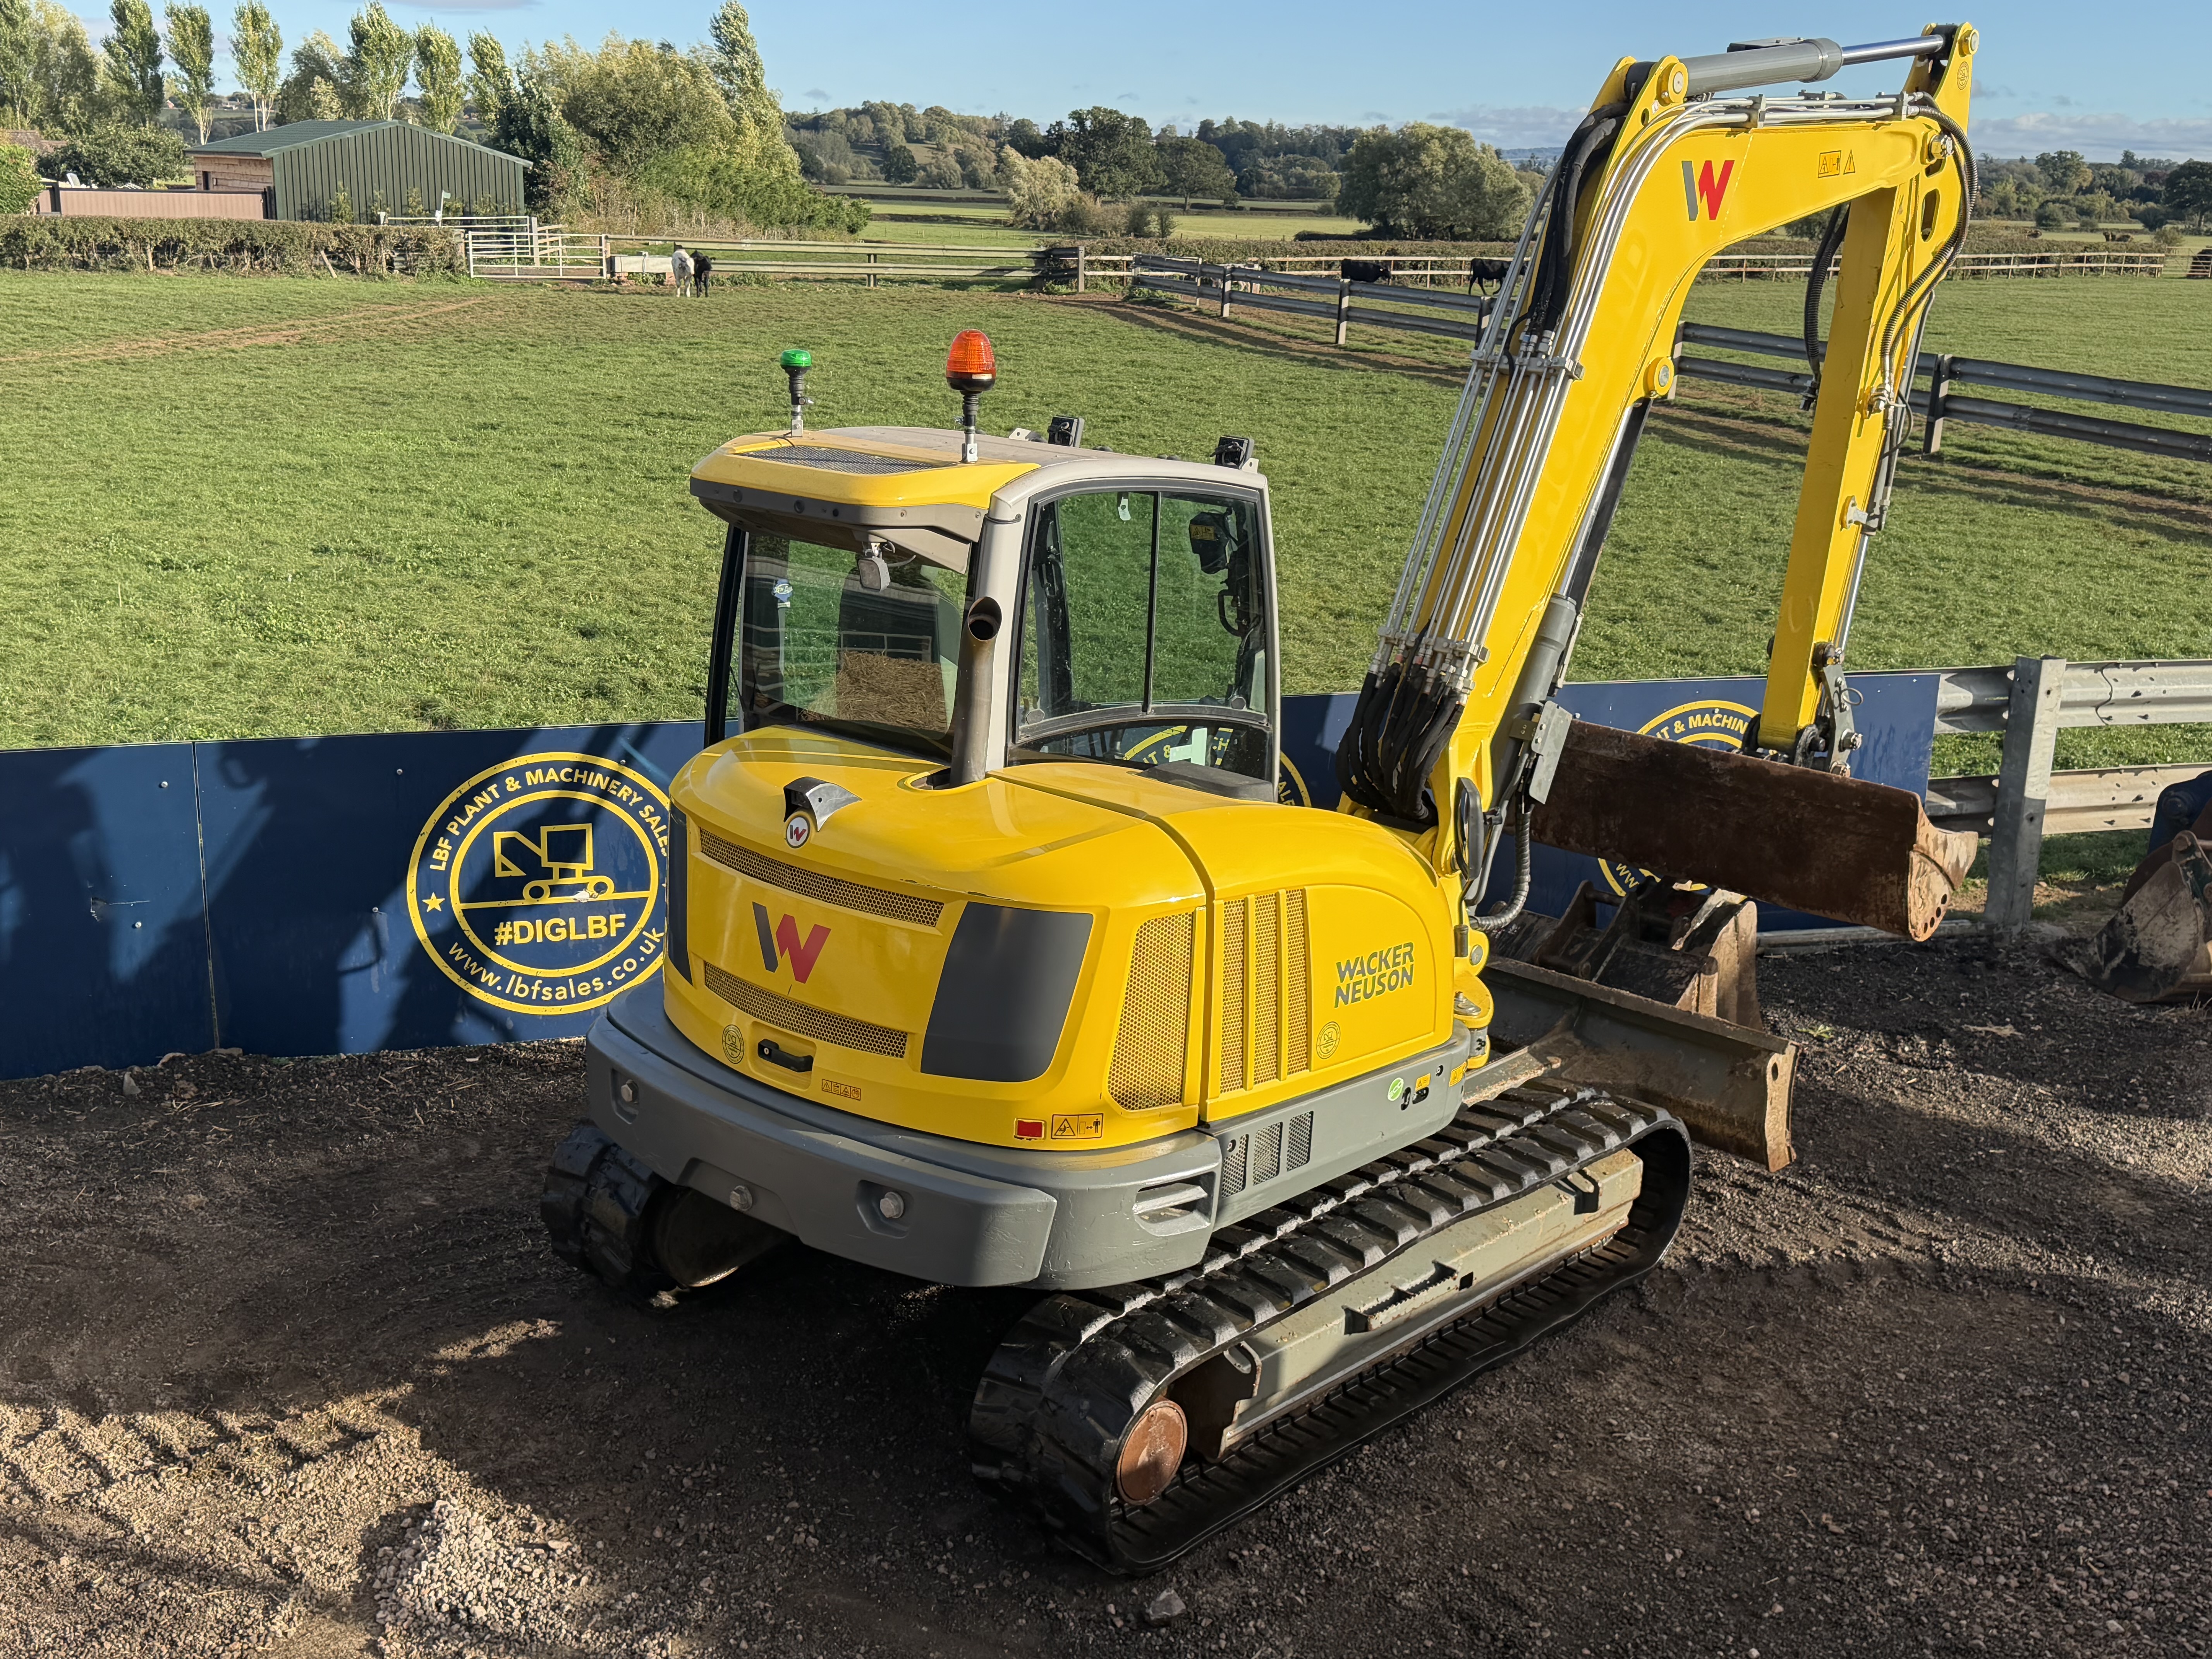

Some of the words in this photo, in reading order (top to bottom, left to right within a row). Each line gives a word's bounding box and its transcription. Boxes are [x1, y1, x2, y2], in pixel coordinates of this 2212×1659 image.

[1674, 720, 1685, 734] &
[1688, 713, 1749, 735] MACHIN
[430, 837, 453, 871] LBF
[447, 784, 501, 836] PLANT
[506, 776, 522, 792] &
[526, 768, 643, 806] MACHINERY
[495, 914, 626, 945] #DIGLBF
[448, 927, 665, 1001] www.lbfsales.co.uk
[1336, 942, 1415, 984] WACKER
[1334, 964, 1415, 1008] NEUSON
